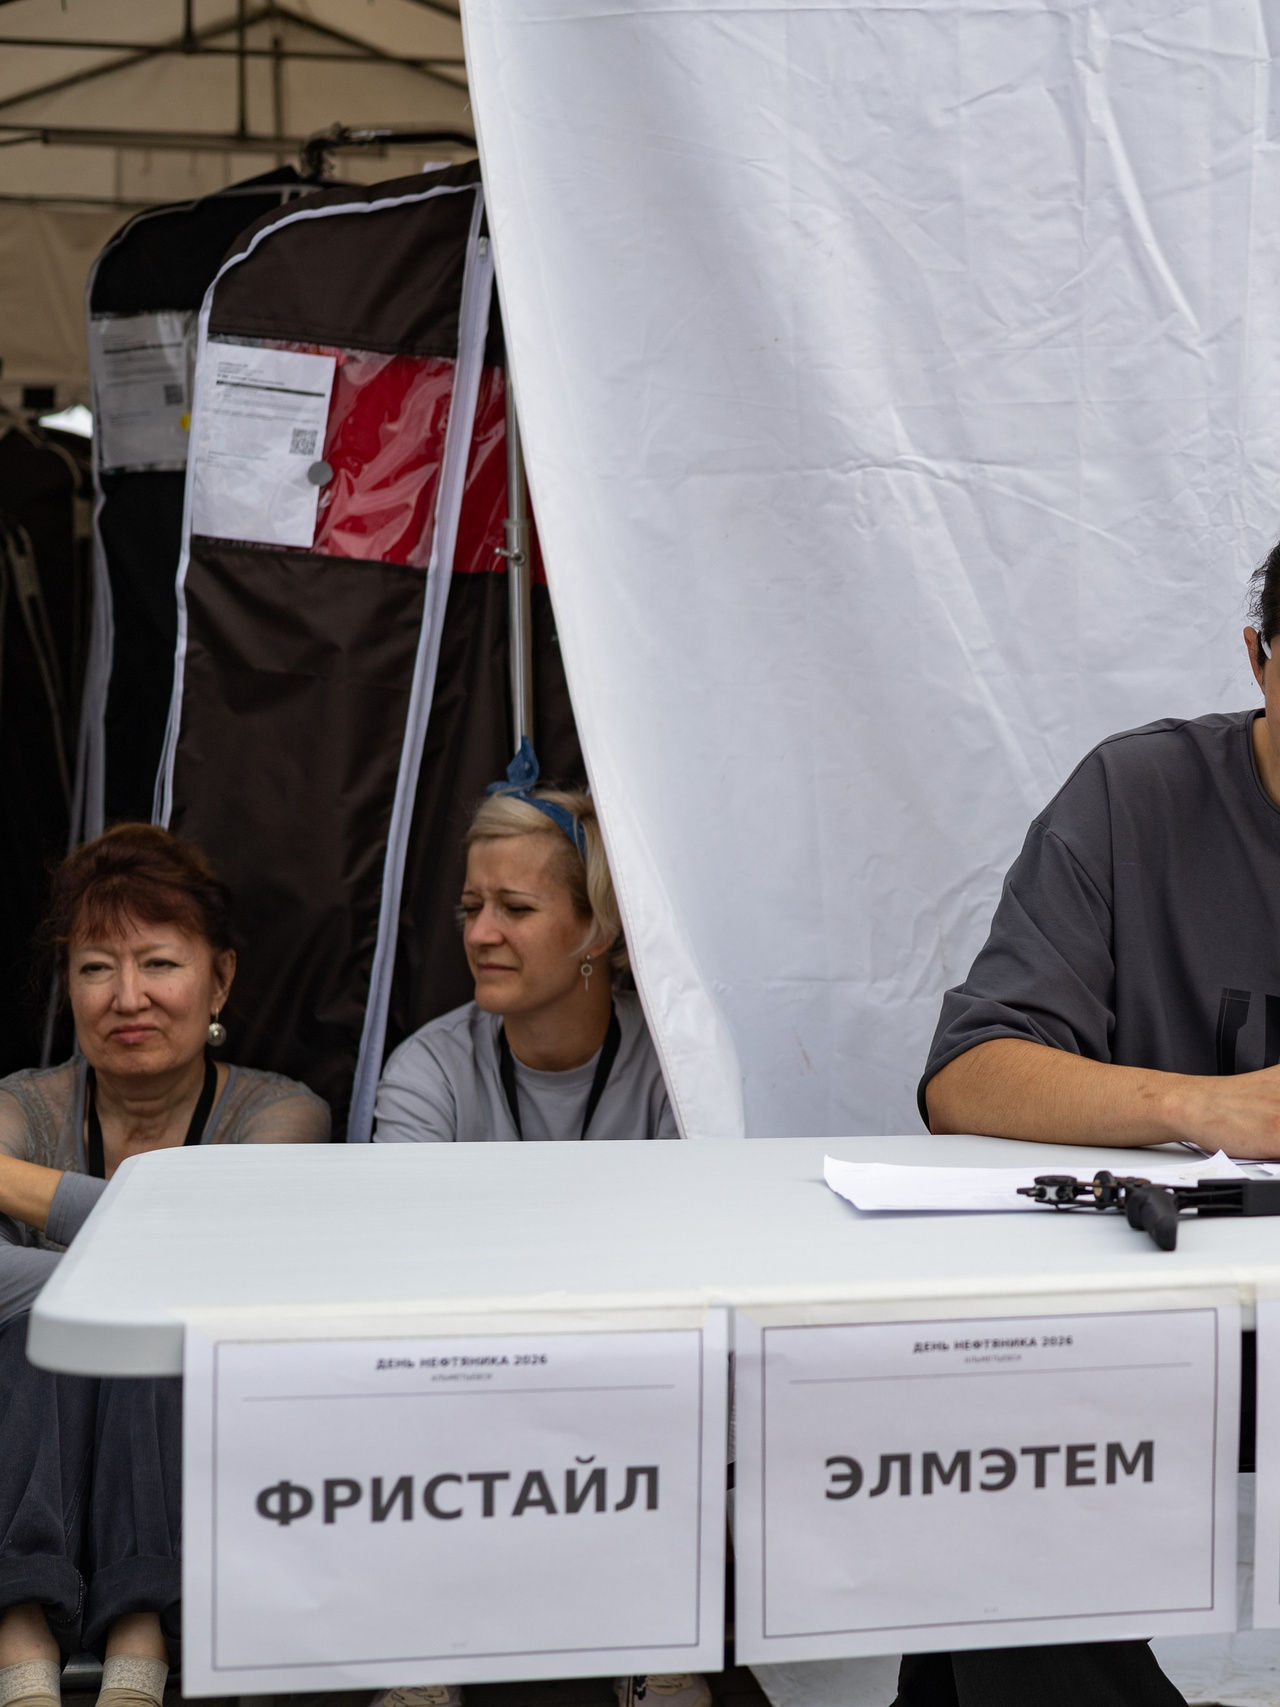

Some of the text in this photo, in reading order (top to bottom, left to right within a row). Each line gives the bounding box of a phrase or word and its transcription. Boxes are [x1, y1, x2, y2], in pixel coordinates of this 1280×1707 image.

[375, 1354, 548, 1371] ДЕНЬ НЕФТЯНИКА 2026
[913, 1335, 1074, 1354] ДЕНЬ НЕФТЯНИКА 2026
[825, 1440, 1154, 1501] ЭЛМЭТЕМ
[255, 1455, 659, 1527] ФРИСТАЙЛ
